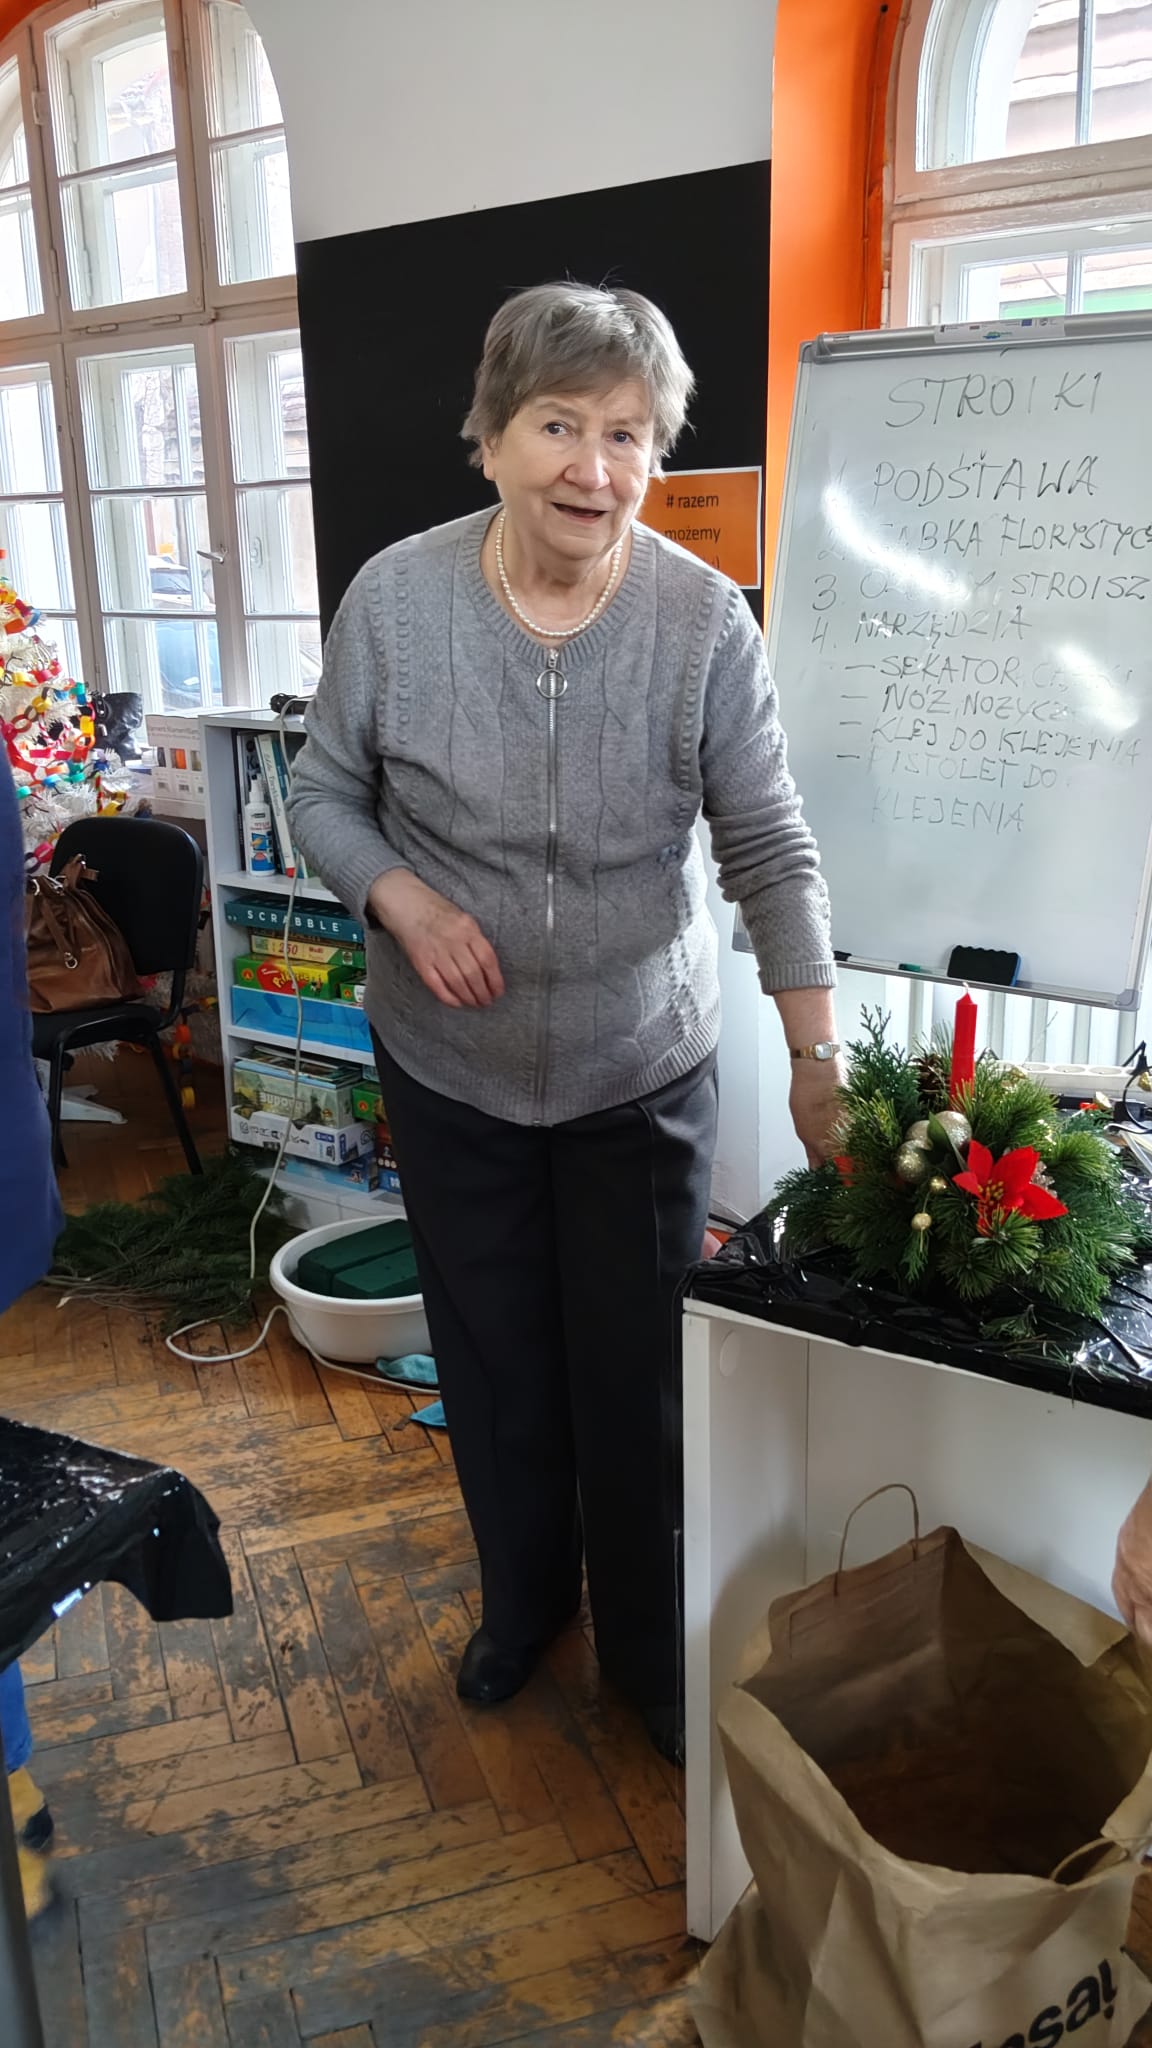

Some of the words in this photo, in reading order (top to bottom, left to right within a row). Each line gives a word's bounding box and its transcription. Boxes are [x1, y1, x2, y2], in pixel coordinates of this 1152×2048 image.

[678, 494, 719, 508] razem
[664, 526, 721, 544] możemy
[870, 716, 938, 746] KLEJ
[949, 727, 987, 751] DO
[999, 727, 1142, 768] KLEJENIA
[866, 744, 1019, 789] PISTOLET
[1023, 764, 1058, 789] DO
[870, 786, 1025, 835] KLEJENIA
